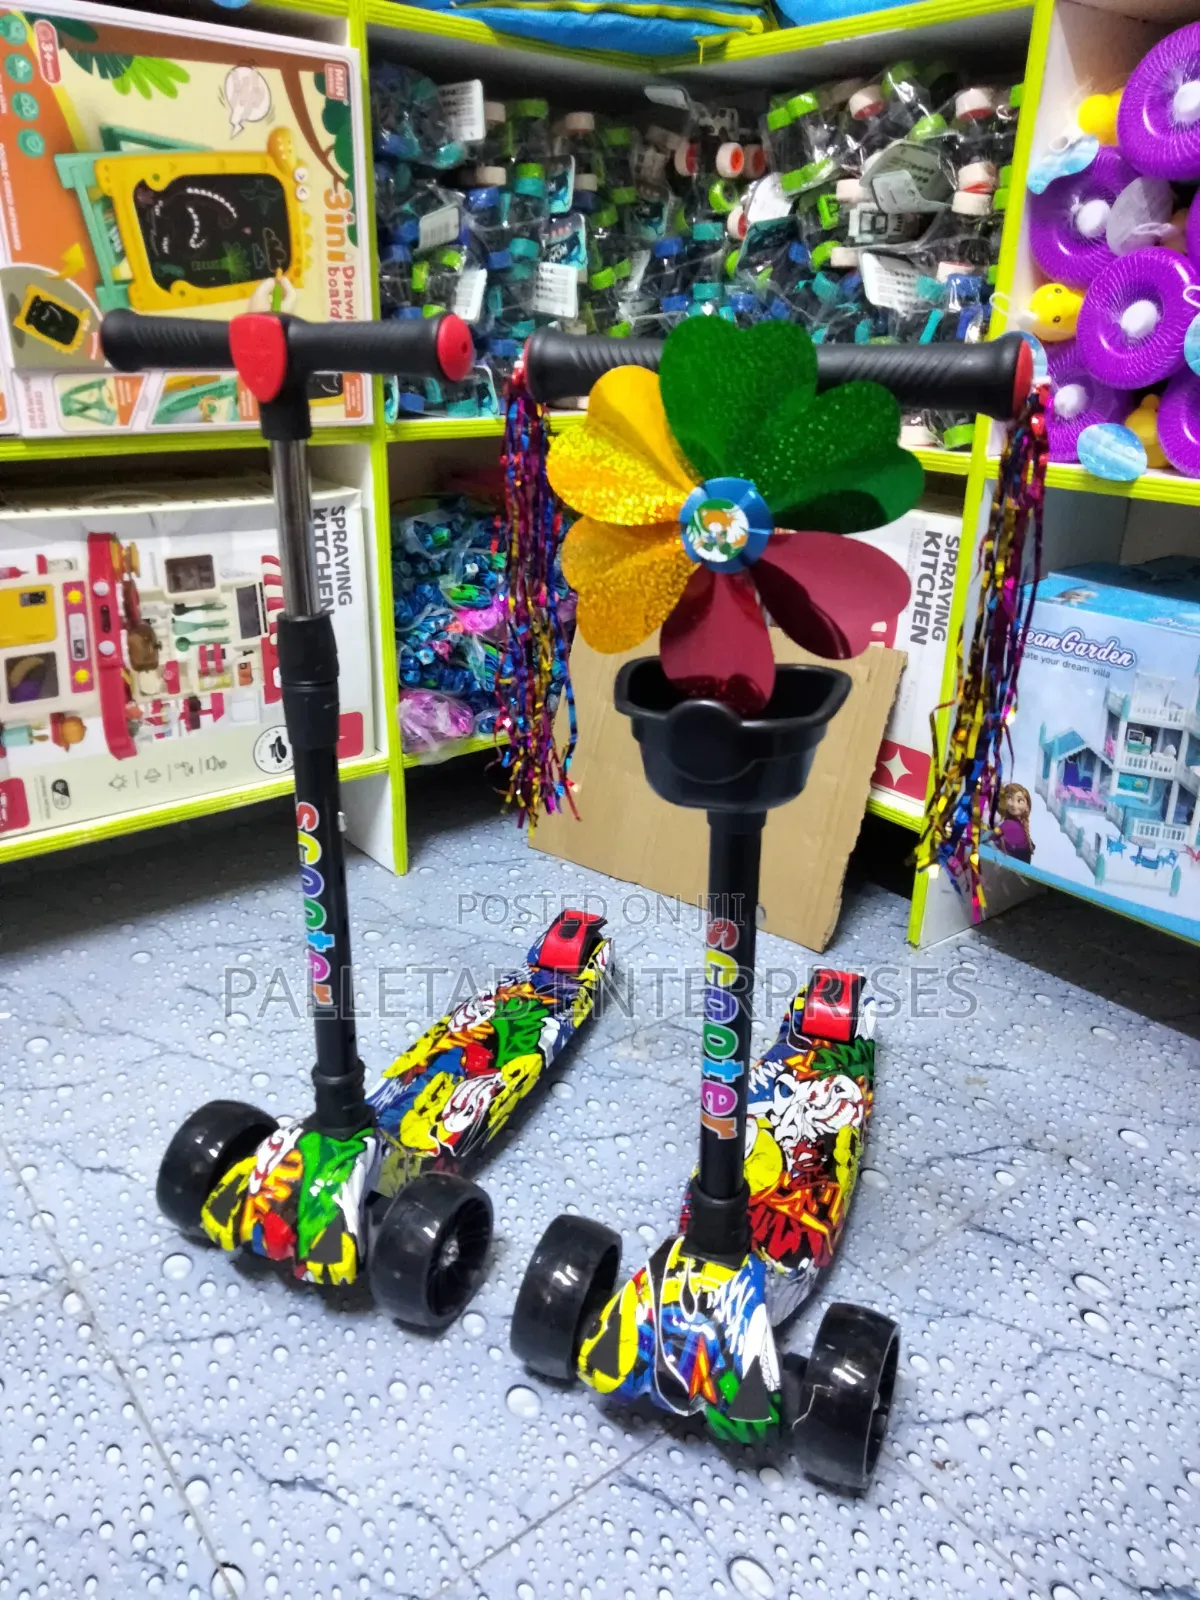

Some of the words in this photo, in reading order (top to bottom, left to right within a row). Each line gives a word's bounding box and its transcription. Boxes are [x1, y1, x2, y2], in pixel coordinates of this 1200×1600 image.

[327, 266, 342, 320] board
[342, 265, 358, 320] Drawi
[313, 507, 335, 615] KITCHEN
[331, 506, 353, 606] SPRAYING
[910, 530, 943, 646] KITCHEN
[931, 534, 960, 642] SPRAYING
[1024, 630, 1136, 667] eamGarden
[1041, 655, 1059, 666] your
[1062, 659, 1090, 673] dream
[1093, 667, 1111, 679] villa
[296, 801, 336, 1006] scooter
[700, 917, 745, 1140] scooter
